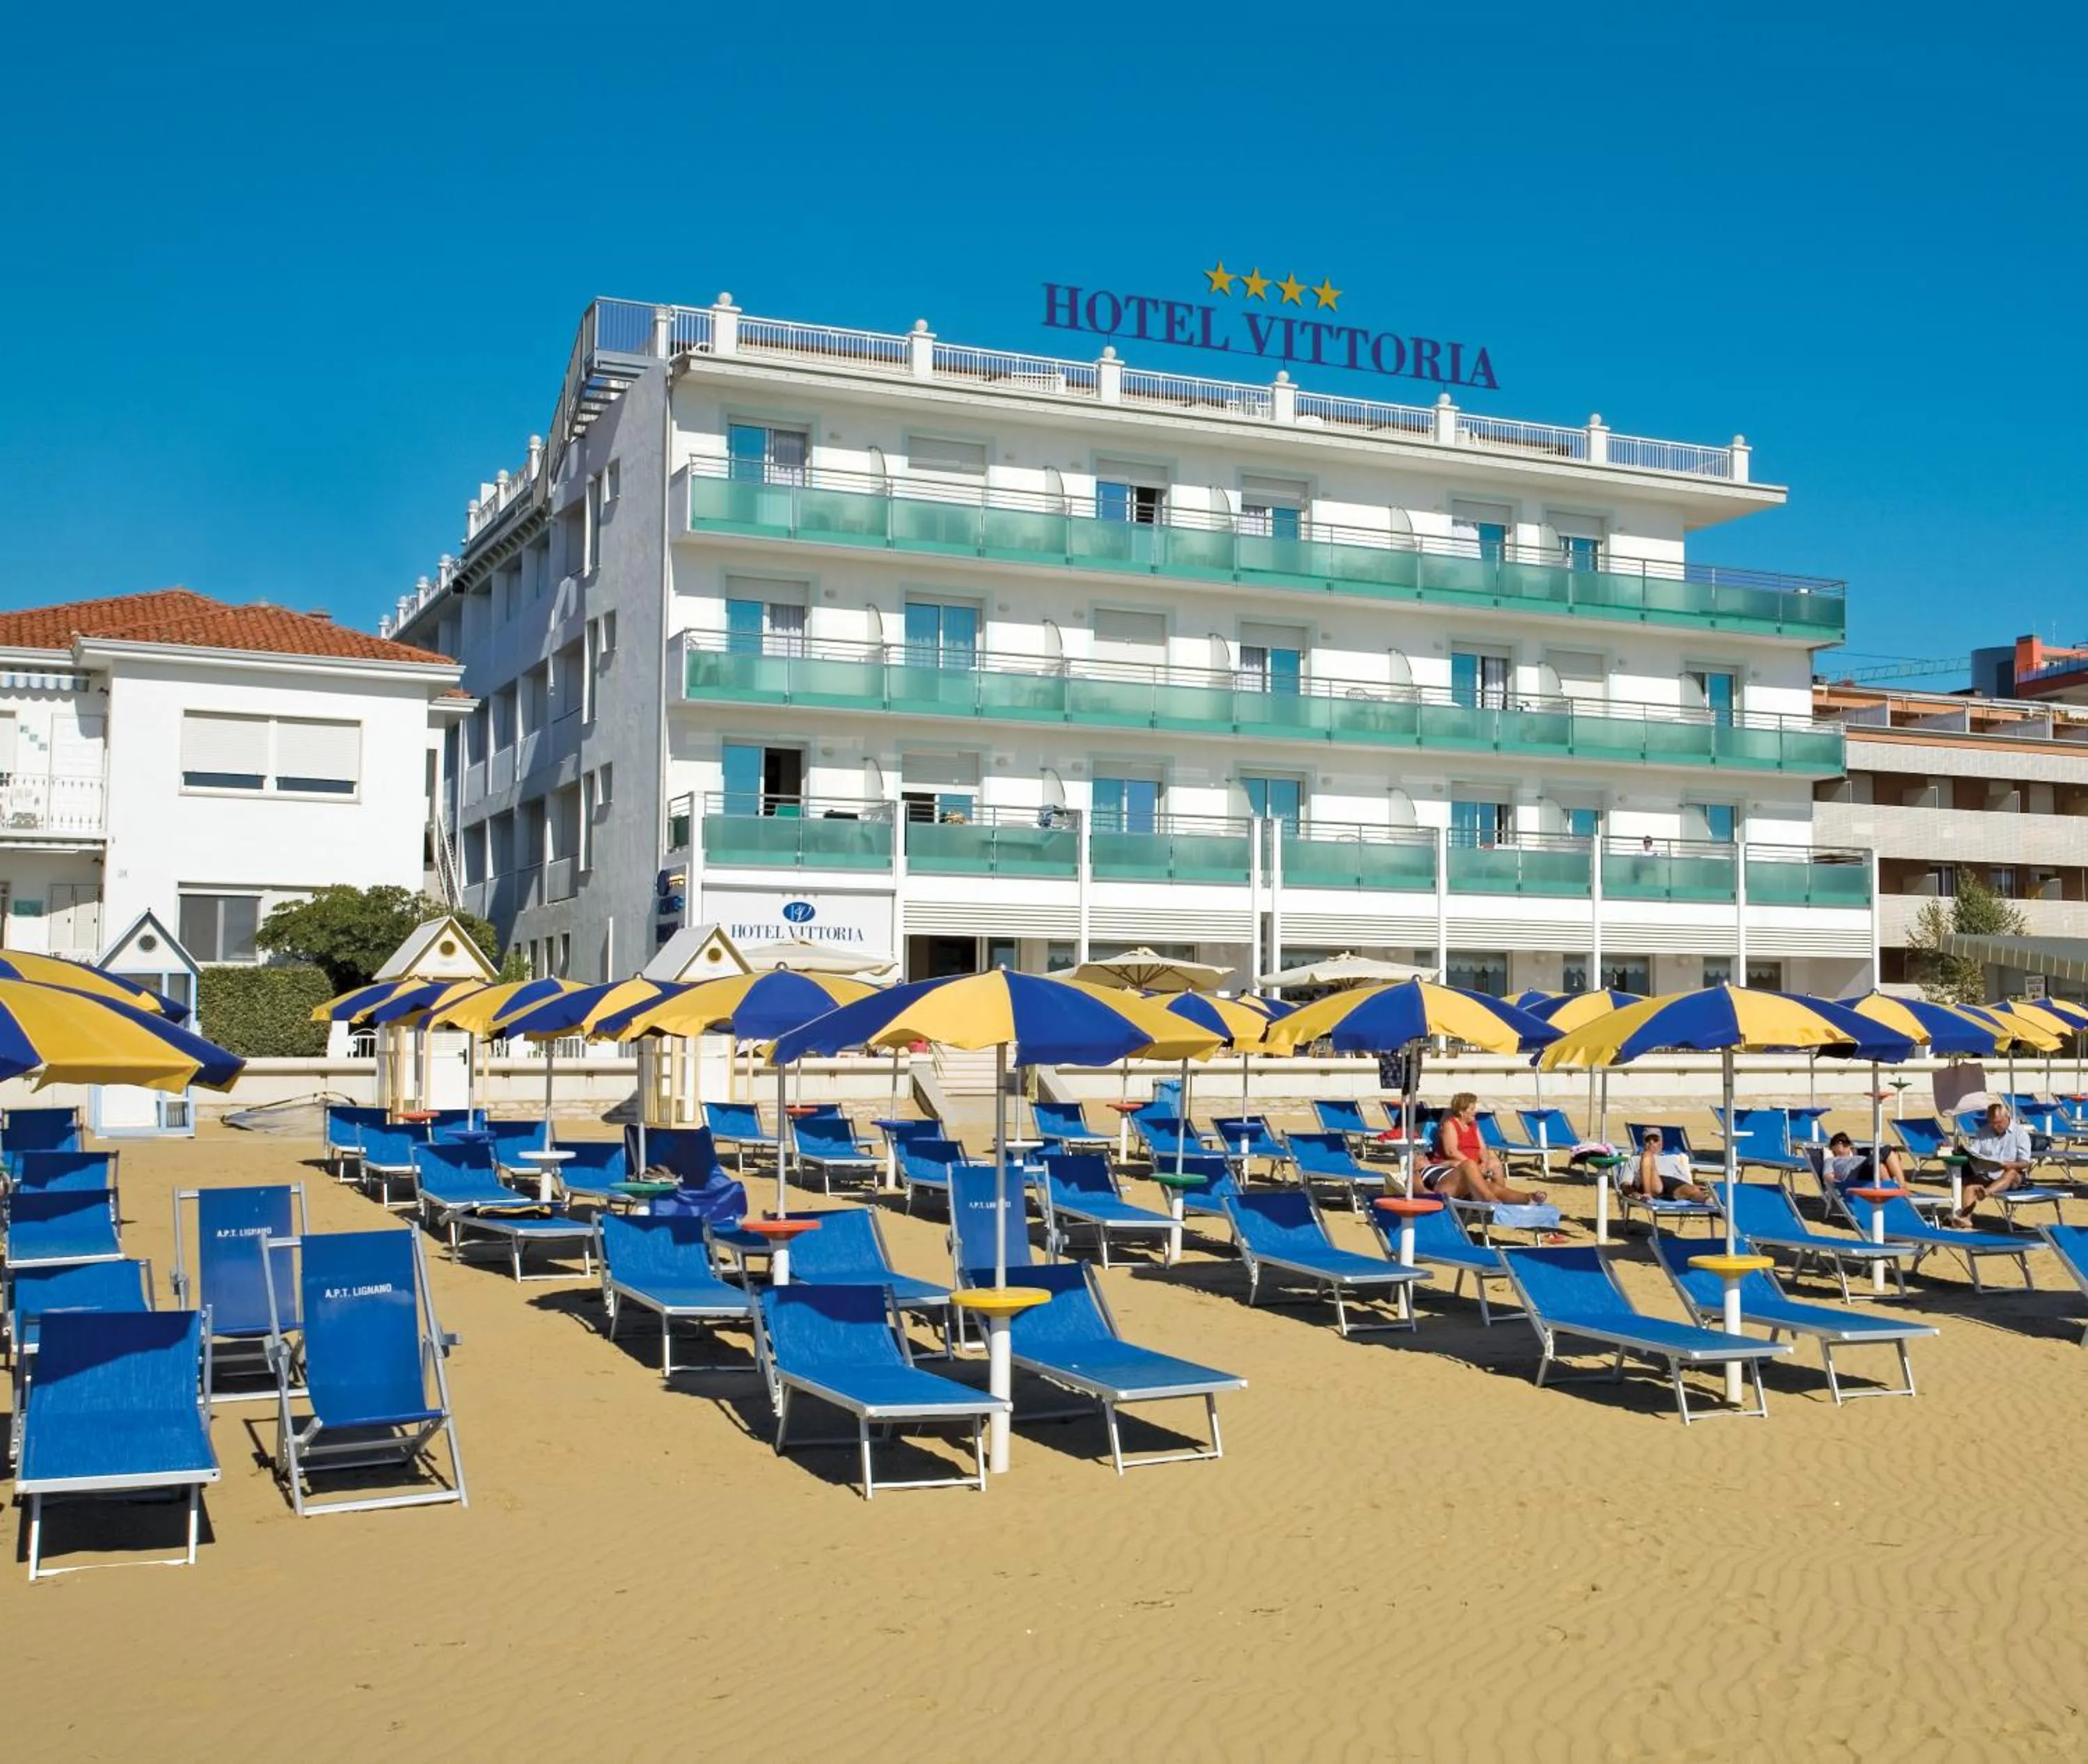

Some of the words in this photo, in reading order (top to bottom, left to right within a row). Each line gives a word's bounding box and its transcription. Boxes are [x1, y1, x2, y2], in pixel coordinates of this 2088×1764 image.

[1041, 282, 1230, 351] HOTEL
[1242, 312, 1500, 389] VITTORIA
[731, 924, 784, 939] HOTEL
[788, 924, 864, 942] VITTORIA
[325, 1288, 351, 1298] A.P.T.
[352, 1283, 392, 1297] LIGNANO
